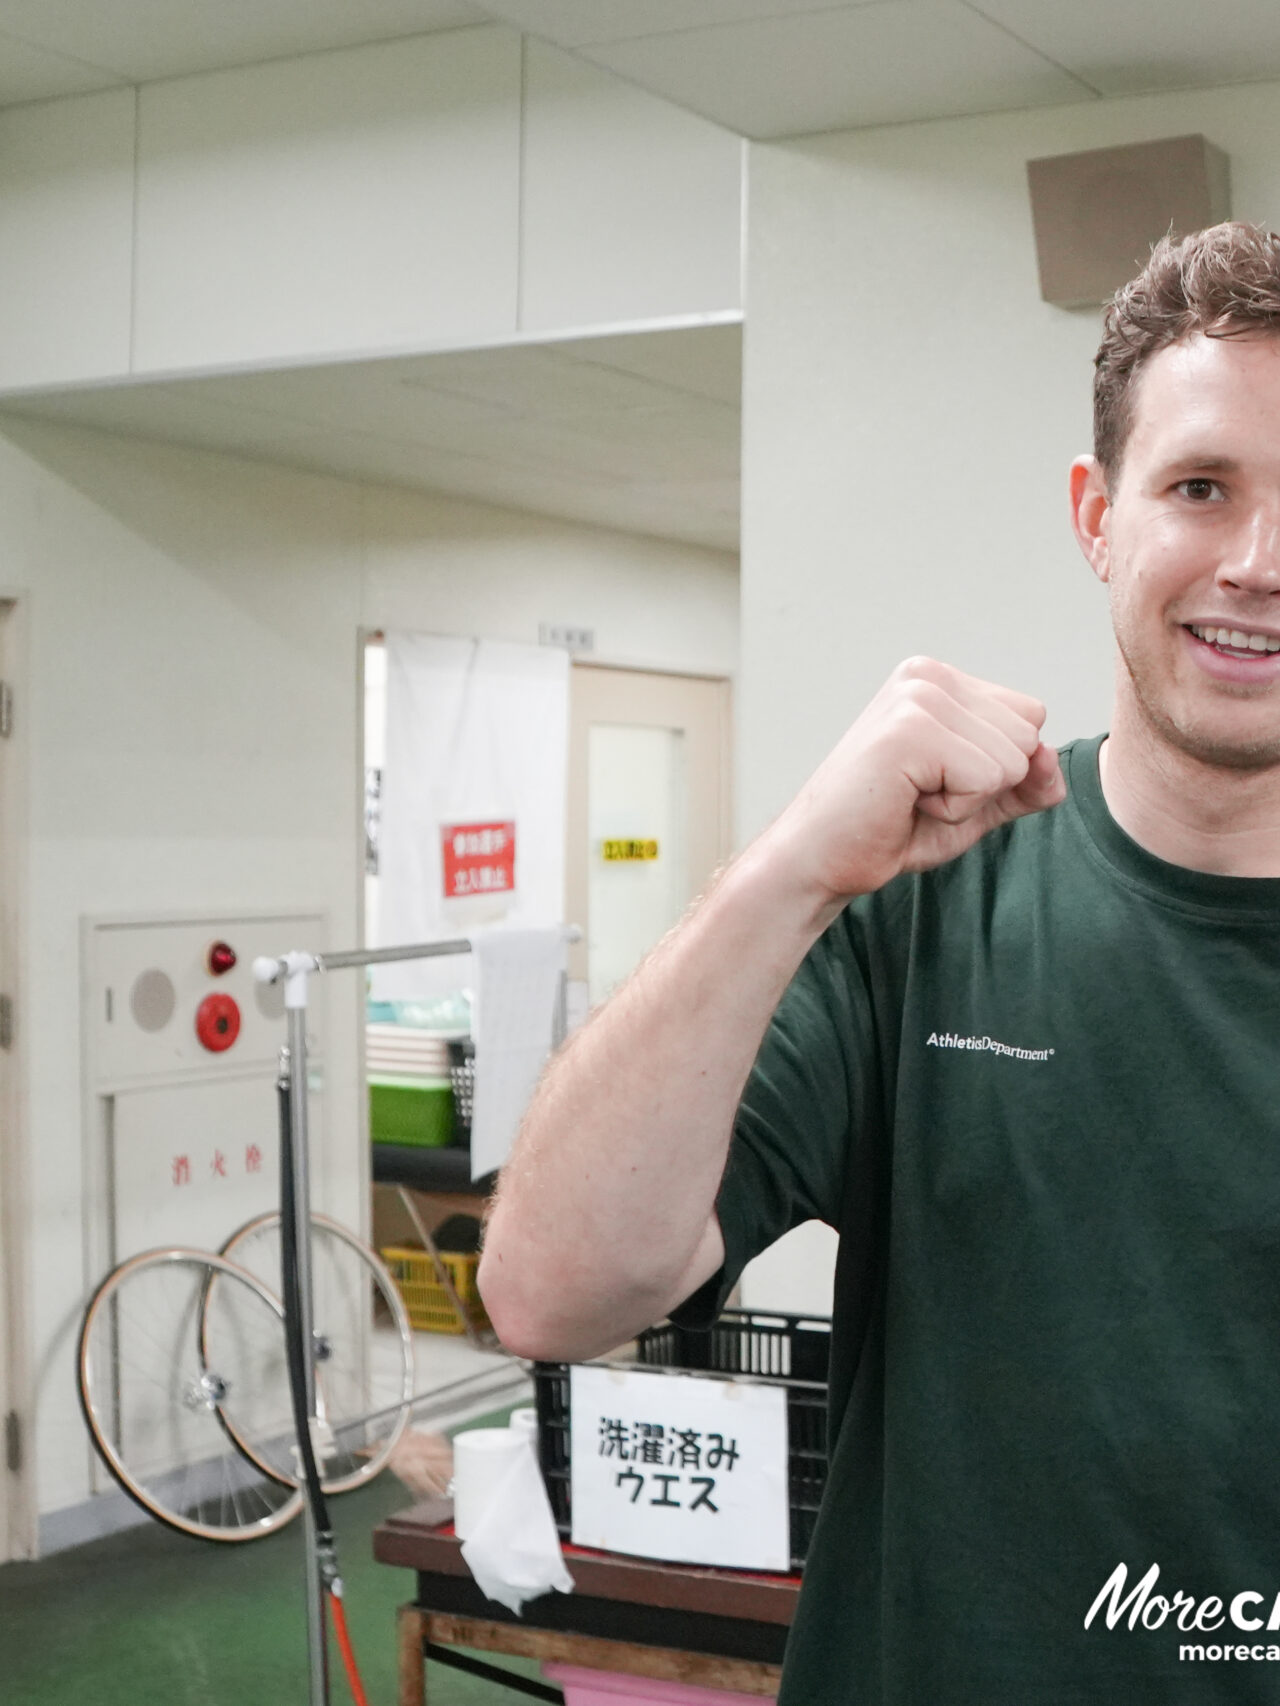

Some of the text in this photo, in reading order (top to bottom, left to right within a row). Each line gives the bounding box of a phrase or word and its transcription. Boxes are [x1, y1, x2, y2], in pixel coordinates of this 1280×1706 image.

[599, 1416, 740, 1471] 洗濯済み
[615, 1466, 719, 1513] ウエス
